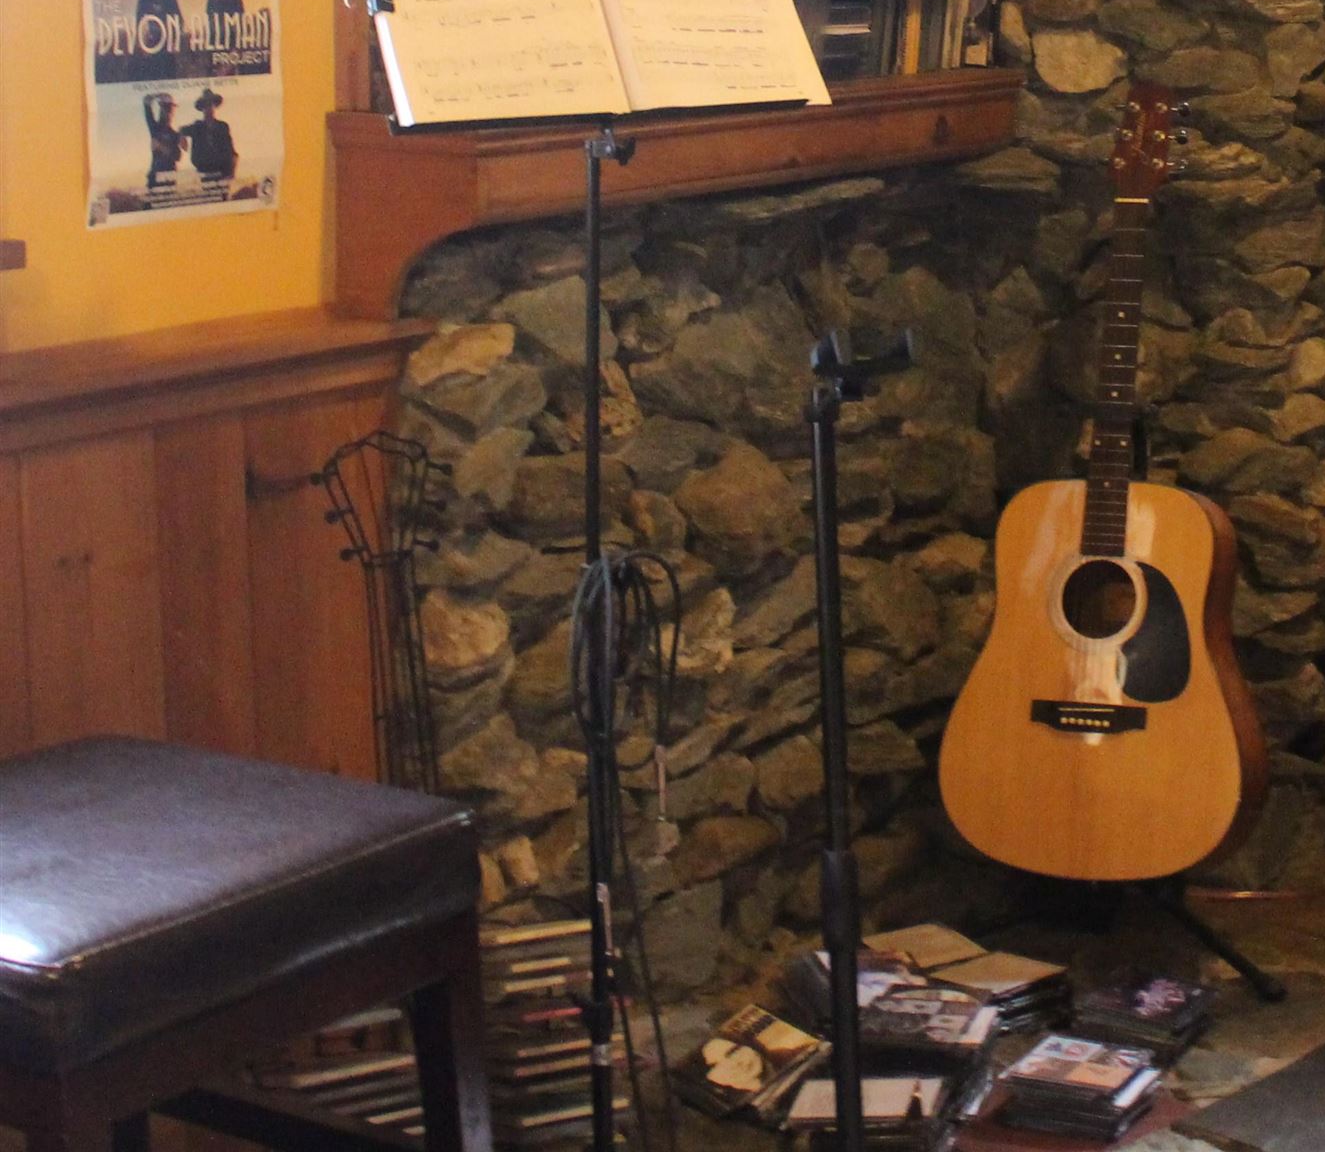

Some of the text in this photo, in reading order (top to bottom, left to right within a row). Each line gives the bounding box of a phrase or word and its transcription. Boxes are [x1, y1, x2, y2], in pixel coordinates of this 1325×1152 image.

[97, 9, 269, 56] DEVON ALLMAN
[212, 51, 269, 65] PROJECT
